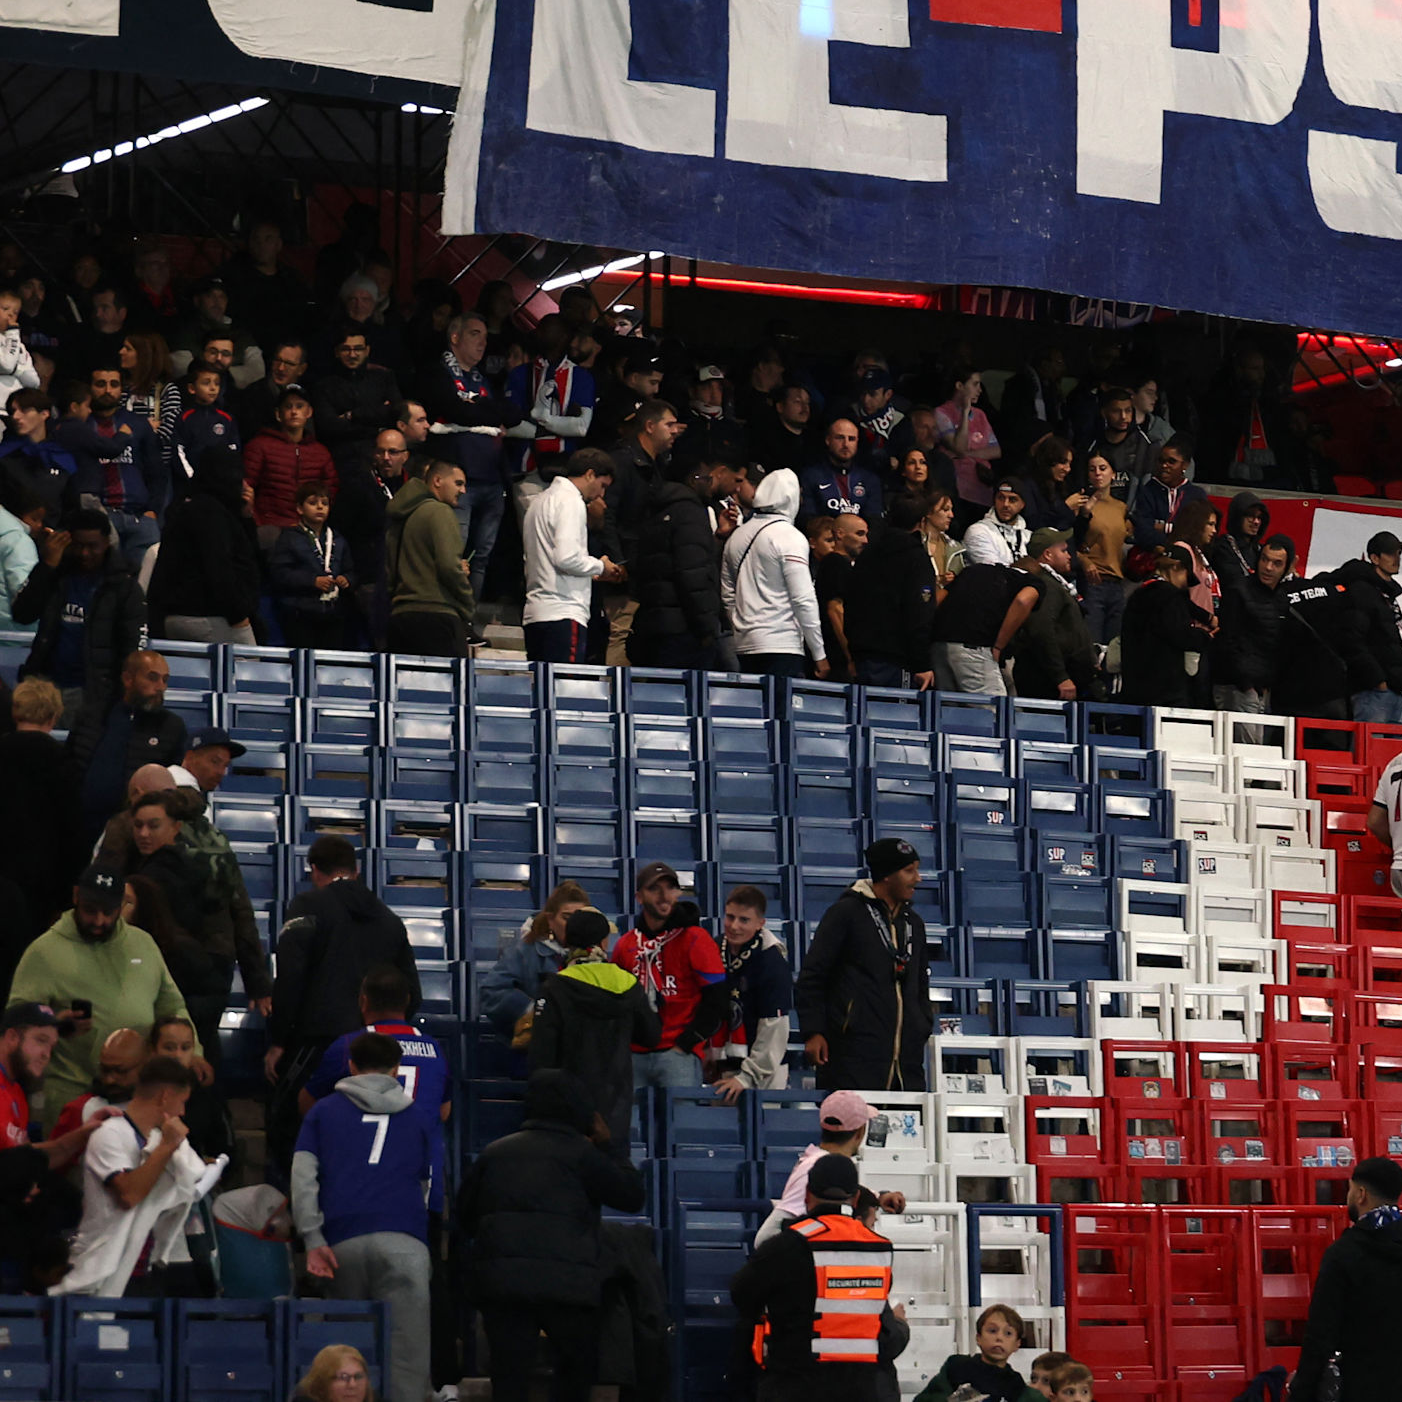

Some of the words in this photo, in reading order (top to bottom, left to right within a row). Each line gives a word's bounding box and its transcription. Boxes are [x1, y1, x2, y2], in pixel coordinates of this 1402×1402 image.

[987, 811, 1004, 824] SUP
[1048, 847, 1066, 860] SUP
[1199, 857, 1216, 871] SUP
[400, 1040, 437, 1059] SKHELIA
[361, 1113, 390, 1164] 7
